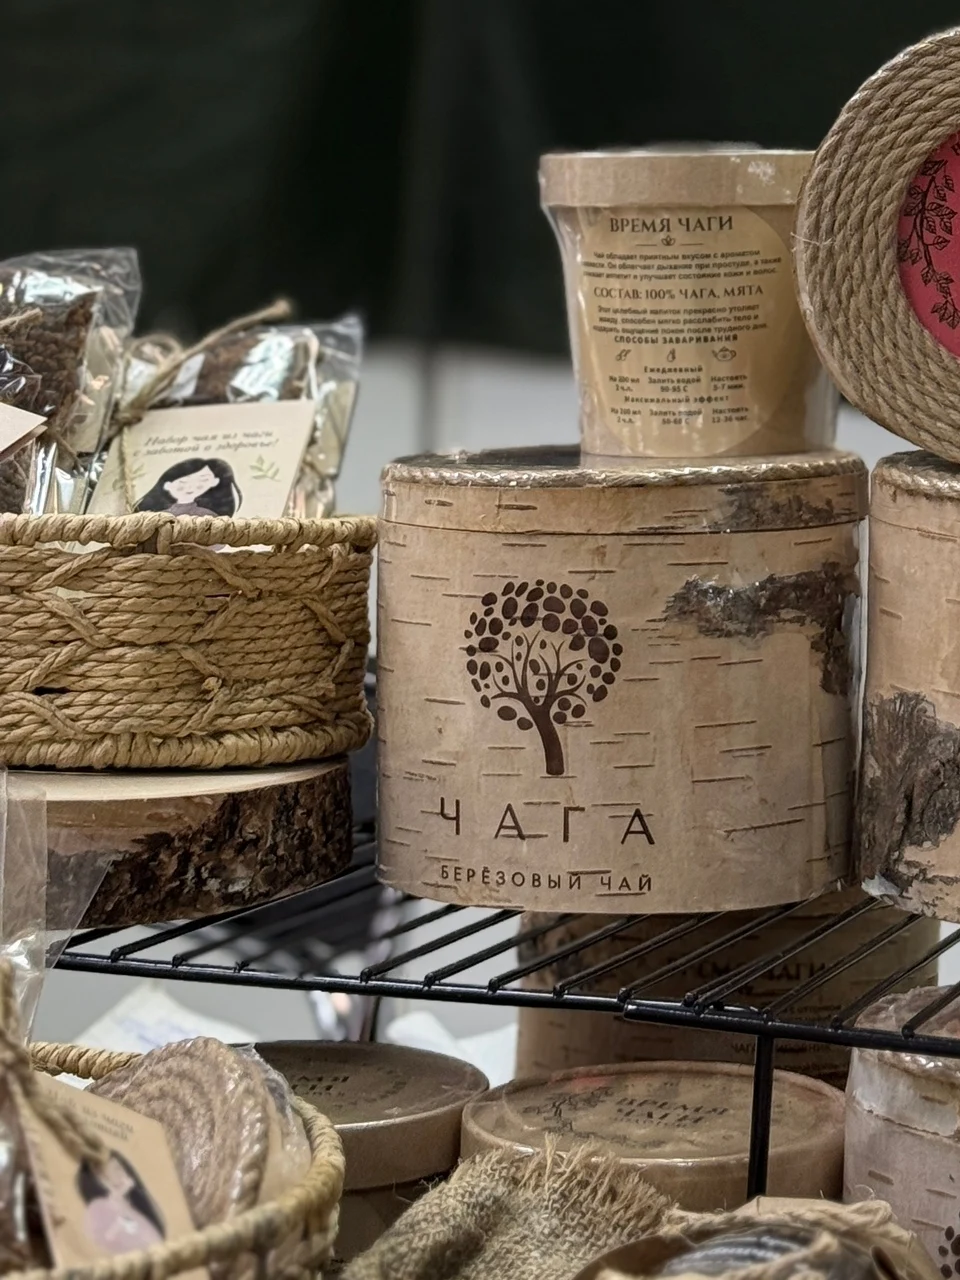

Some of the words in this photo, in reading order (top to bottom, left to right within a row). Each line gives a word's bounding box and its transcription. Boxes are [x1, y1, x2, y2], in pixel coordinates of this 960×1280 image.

[609, 217, 671, 233] ВРЕМЯ
[677, 215, 734, 232] ЧАГИ
[682, 252, 711, 262] вкусом
[695, 262, 711, 271] при
[593, 286, 643, 300] СОСТАВ:
[645, 288, 676, 300] 100%
[723, 285, 764, 297] МЯТА
[683, 306, 727, 316] прекрасно
[687, 326, 712, 334] после
[714, 323, 752, 333] трудного
[614, 335, 660, 344] СПОСОБЫ
[662, 333, 739, 345] ЗАВАРИВАНИЯ
[648, 376, 676, 384] Залить
[710, 374, 748, 383] Настоять
[624, 395, 690, 404] Максимальный
[693, 395, 729, 404] эффект
[440, 796, 656, 846] ЧАГА
[440, 864, 583, 891] БЕРЁЗОВЫЙ
[599, 873, 653, 893] ЧАЙ
